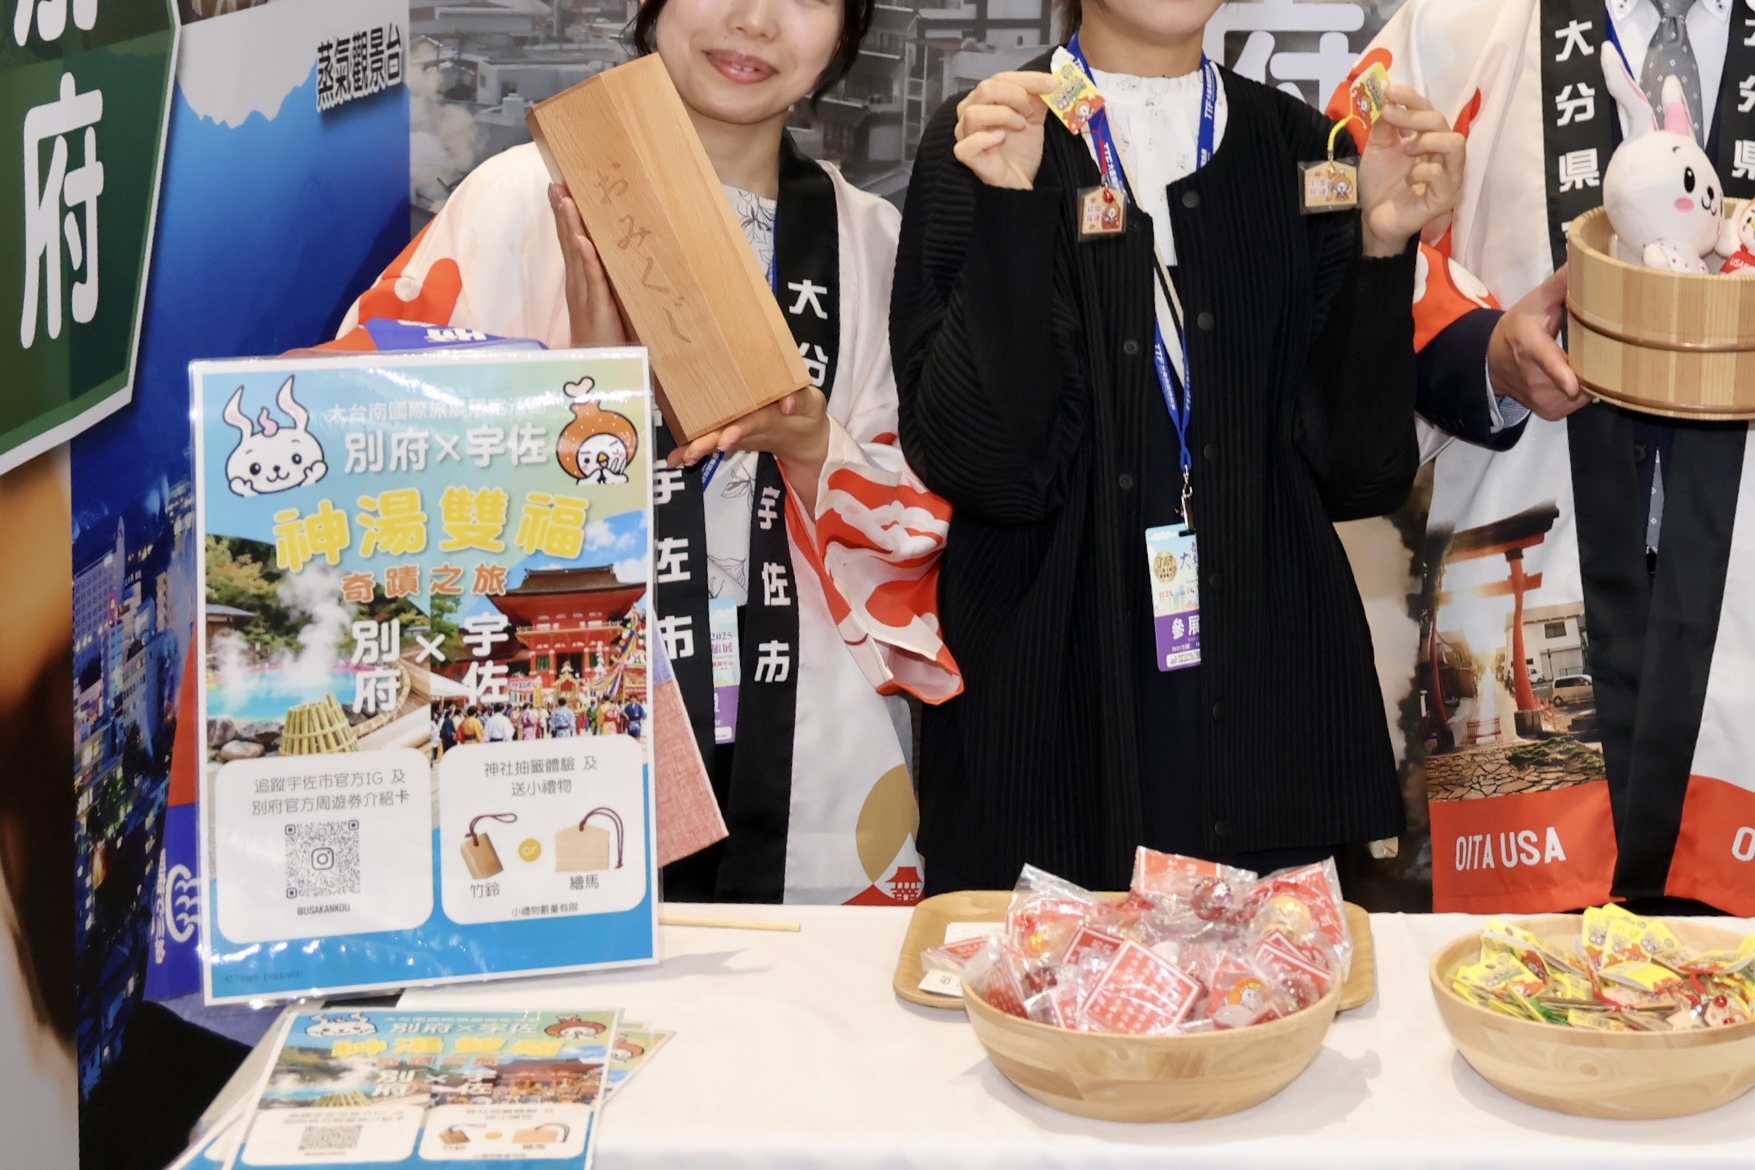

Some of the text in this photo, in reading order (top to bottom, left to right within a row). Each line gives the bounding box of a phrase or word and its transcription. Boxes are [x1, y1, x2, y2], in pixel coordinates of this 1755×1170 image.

[316, 22, 401, 112] 蒸氣觀景台
[272, 485, 590, 574] 神湯雙福
[341, 562, 510, 604] 奇蹟之旅
[754, 486, 792, 684] 宇佐市
[351, 618, 400, 714] 別府
[463, 612, 509, 705] 宇佐
[391, 768, 407, 785] 及
[484, 755, 598, 778] 神社抽籤體驗 及
[511, 778, 572, 798] 送小禮物
[522, 845, 538, 856] or
[1455, 825, 1567, 872] OITA USA
[470, 882, 501, 899] 竹鈴
[569, 874, 600, 891] 繪馬
